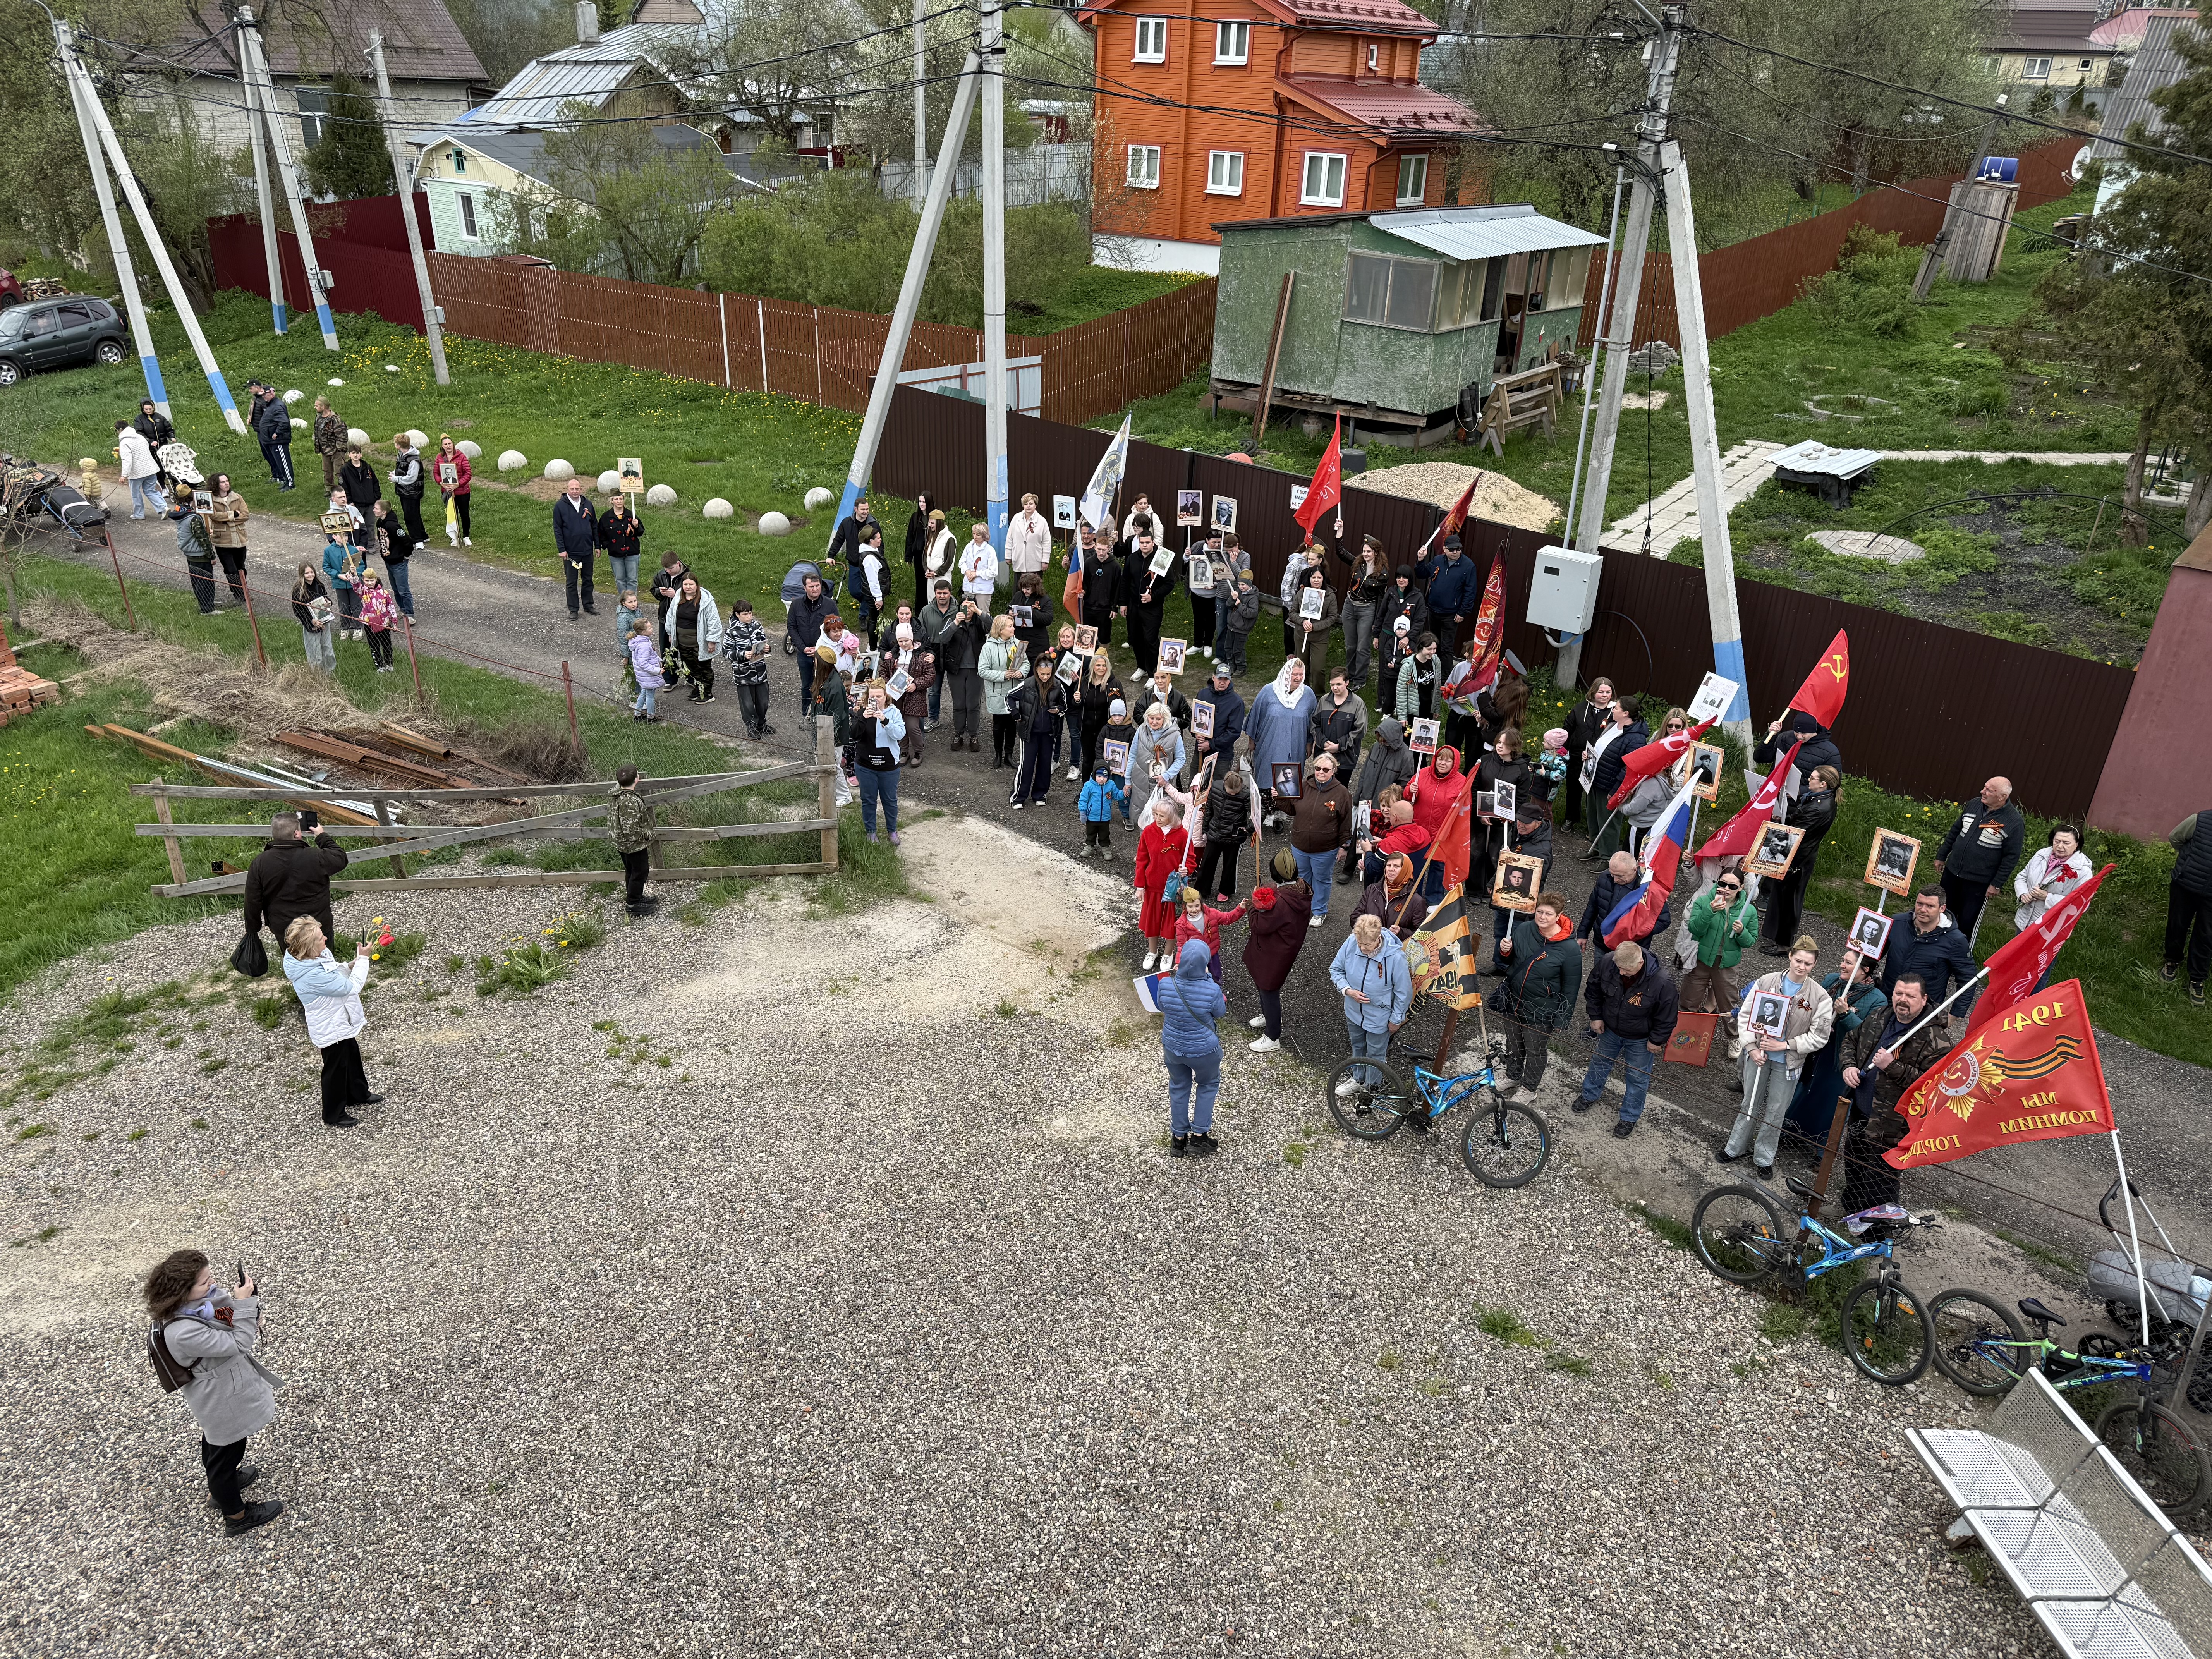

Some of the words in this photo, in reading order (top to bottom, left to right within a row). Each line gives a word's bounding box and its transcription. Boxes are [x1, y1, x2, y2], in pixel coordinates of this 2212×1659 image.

[1449, 1083, 1480, 1104] STELS
[1828, 1247, 1872, 1265] STELS
[2070, 1371, 2125, 1387] STELS
